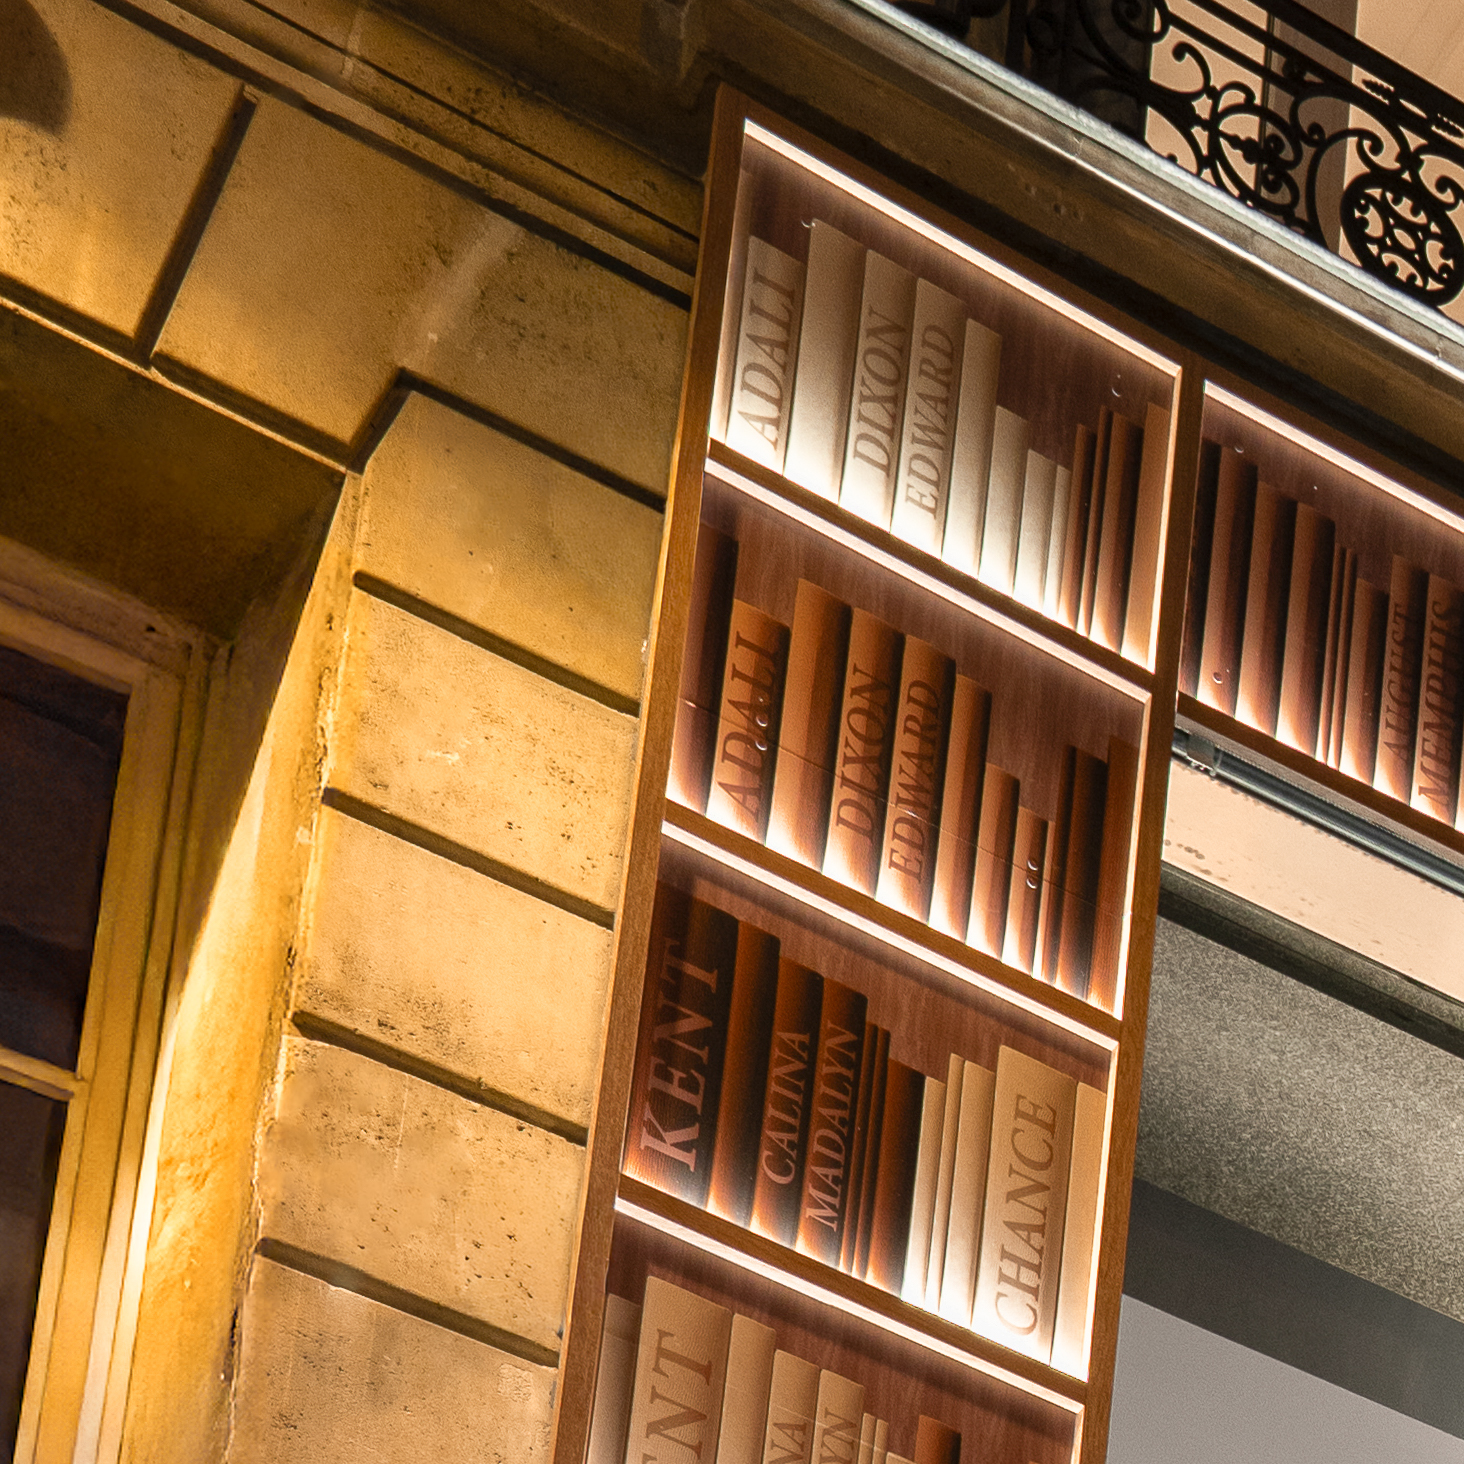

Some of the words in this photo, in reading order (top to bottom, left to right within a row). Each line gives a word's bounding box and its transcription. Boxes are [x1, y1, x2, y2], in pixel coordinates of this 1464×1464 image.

[737, 266, 796, 449] ADALI
[853, 304, 907, 475] DIXON
[905, 324, 955, 519] EDWARD
[716, 631, 780, 821] ADALI
[836, 664, 891, 842] DIXON
[1384, 602, 1422, 762] AUGUST
[1419, 600, 1459, 810] MEMPHIS
[889, 679, 941, 884] EDWARD
[639, 938, 718, 1172] KENT
[763, 1030, 811, 1186] CALINA
[806, 1020, 860, 1232] MADALYN
[994, 1093, 1056, 1336] CHANCE
